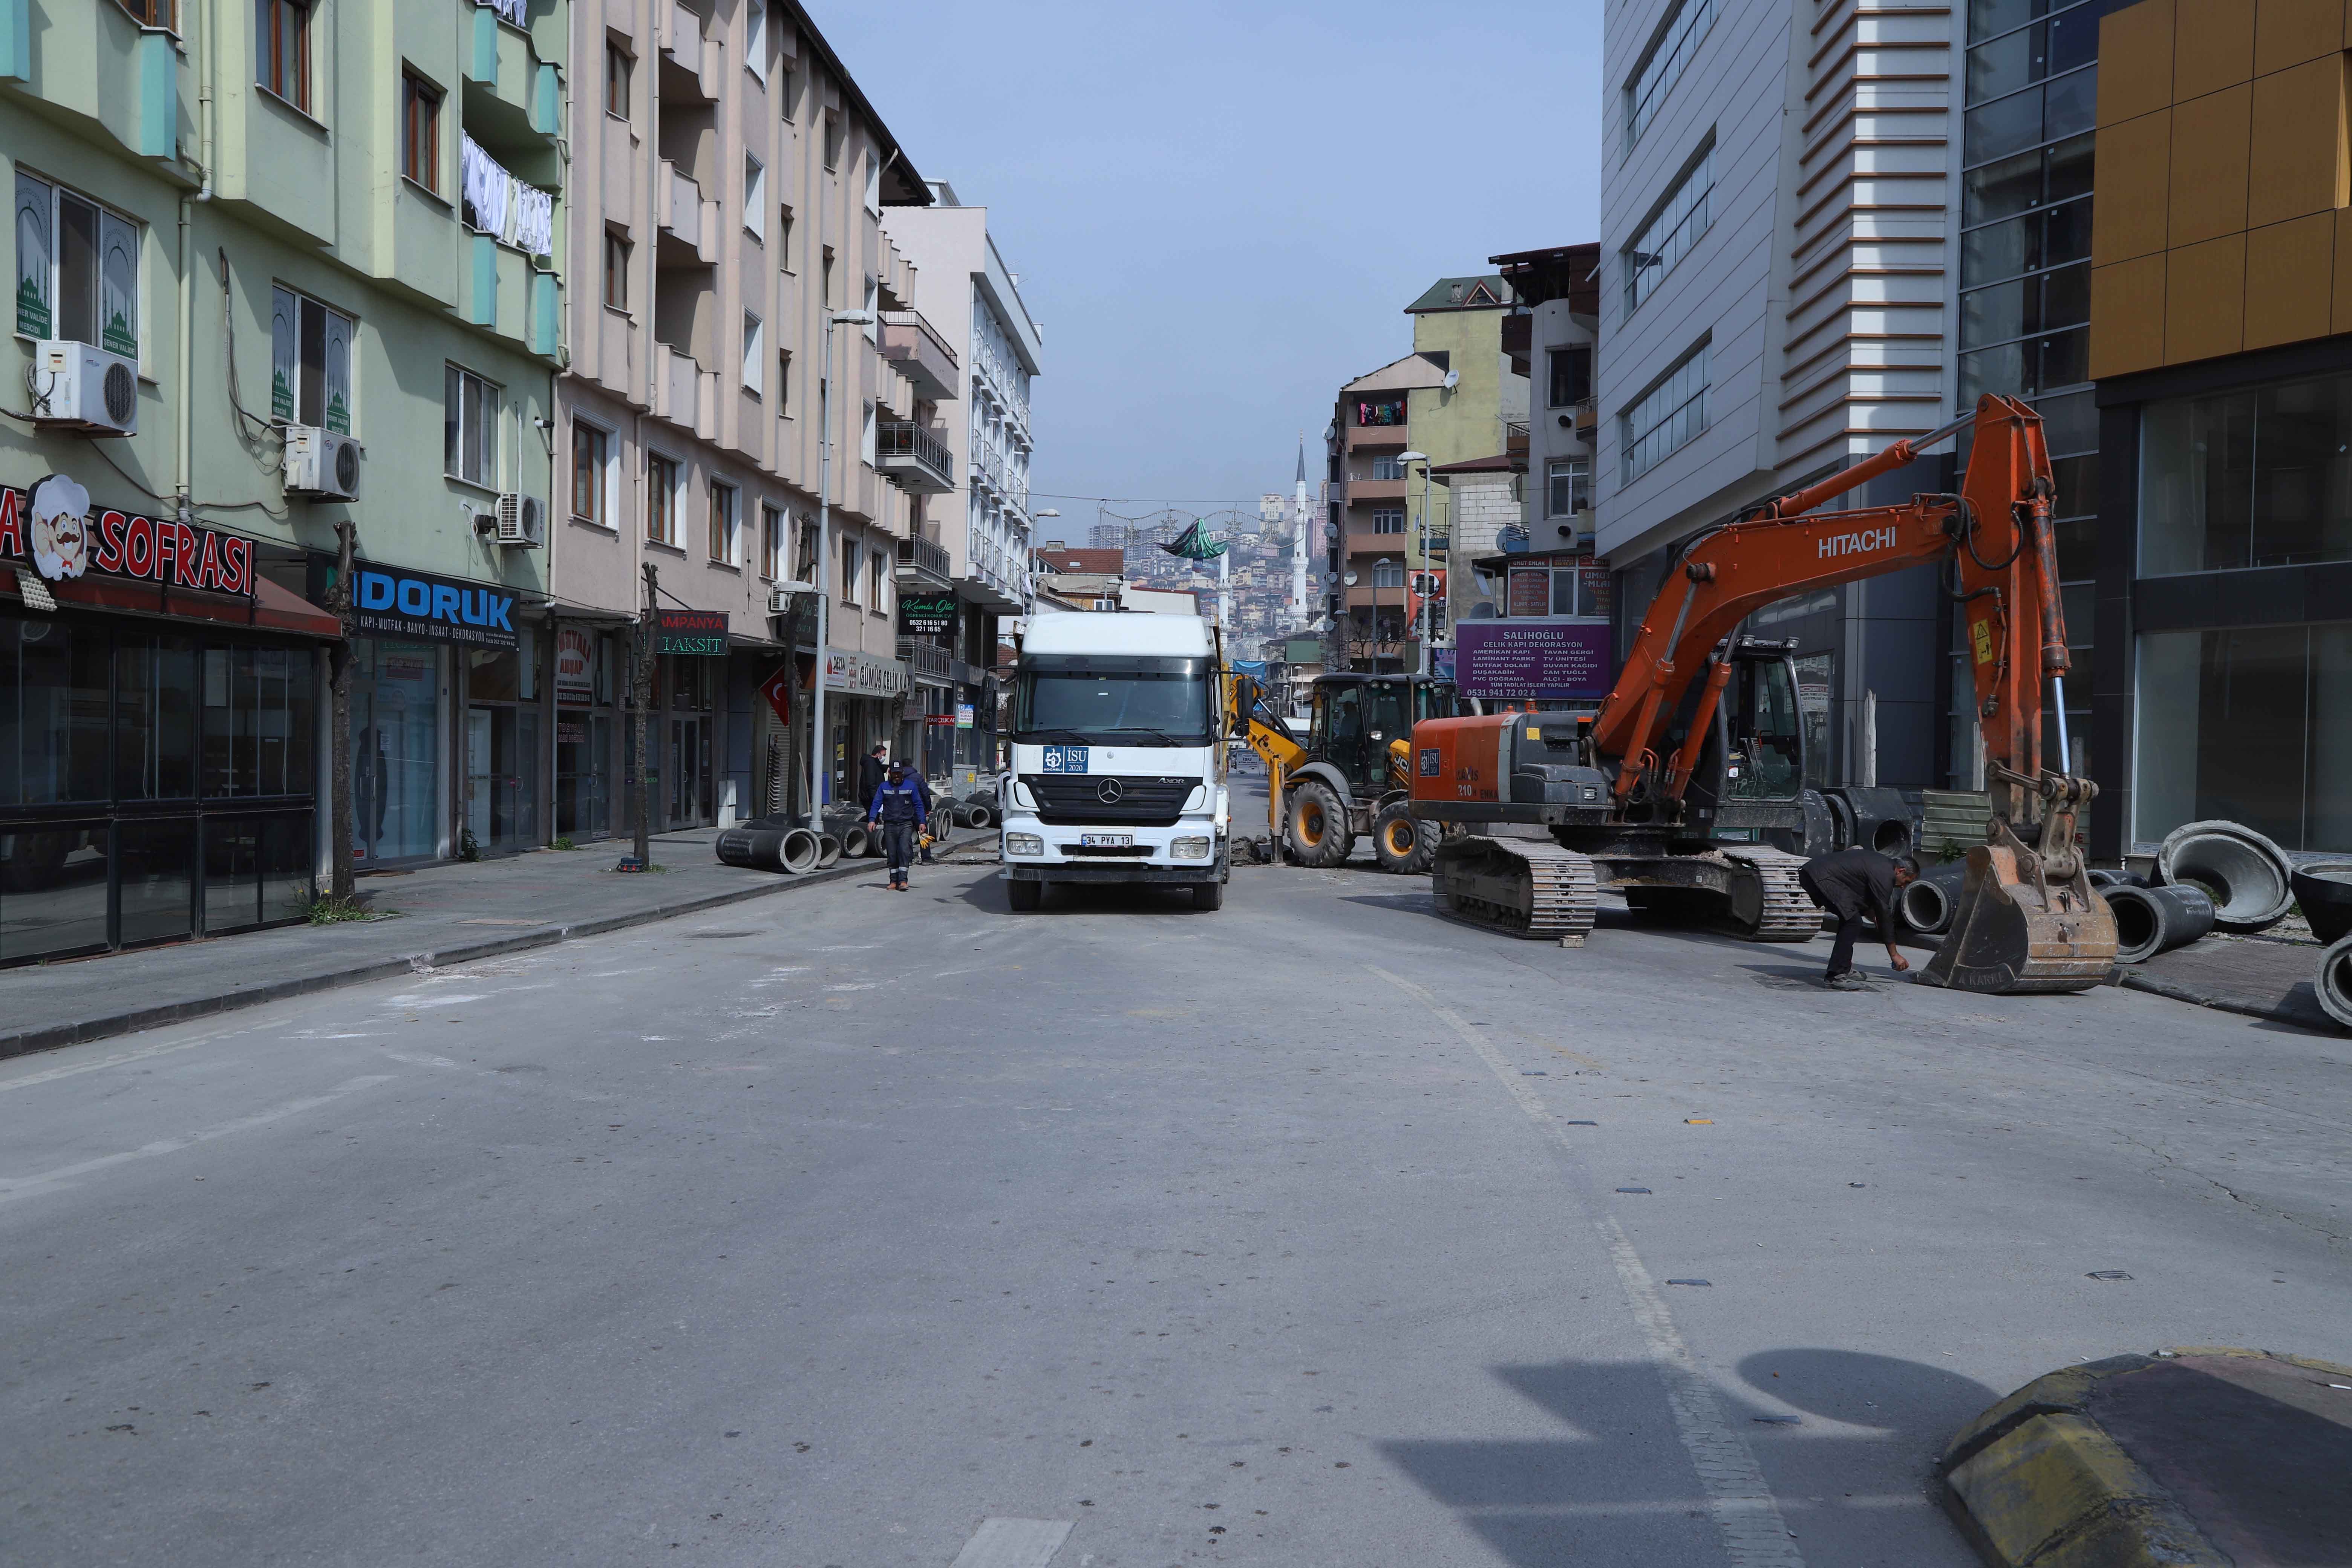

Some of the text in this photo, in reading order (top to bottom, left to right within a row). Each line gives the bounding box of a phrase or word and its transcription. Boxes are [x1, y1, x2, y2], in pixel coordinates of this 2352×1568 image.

[30, 311, 48, 325] VALİDE
[19, 320, 40, 335] MESCİDİ
[104, 338, 135, 355] ŞENER VALİDE
[1818, 526, 1896, 559] HITACHI
[95, 510, 253, 596] SOFRASI
[361, 571, 514, 632] DORUK
[902, 598, 956, 613] Kumlu Otel
[360, 616, 374, 628] KAPI
[378, 617, 402, 632] MUTFAK
[407, 622, 425, 635] BANYO
[453, 628, 484, 642] DEKORASYON
[661, 616, 724, 630] AMPANYA
[1503, 629, 1564, 640] SALİHOĞLU
[662, 636, 721, 652] TAKSİT
[859, 661, 882, 696] GÜMÜŞ
[883, 667, 898, 697] ÇELİK
[1067, 747, 1087, 762] İSU
[1430, 750, 1439, 764] İSU
[1395, 752, 1409, 773] JC
[1458, 784, 1472, 796] 210
[1087, 836, 1130, 845] 34 PYA 13
